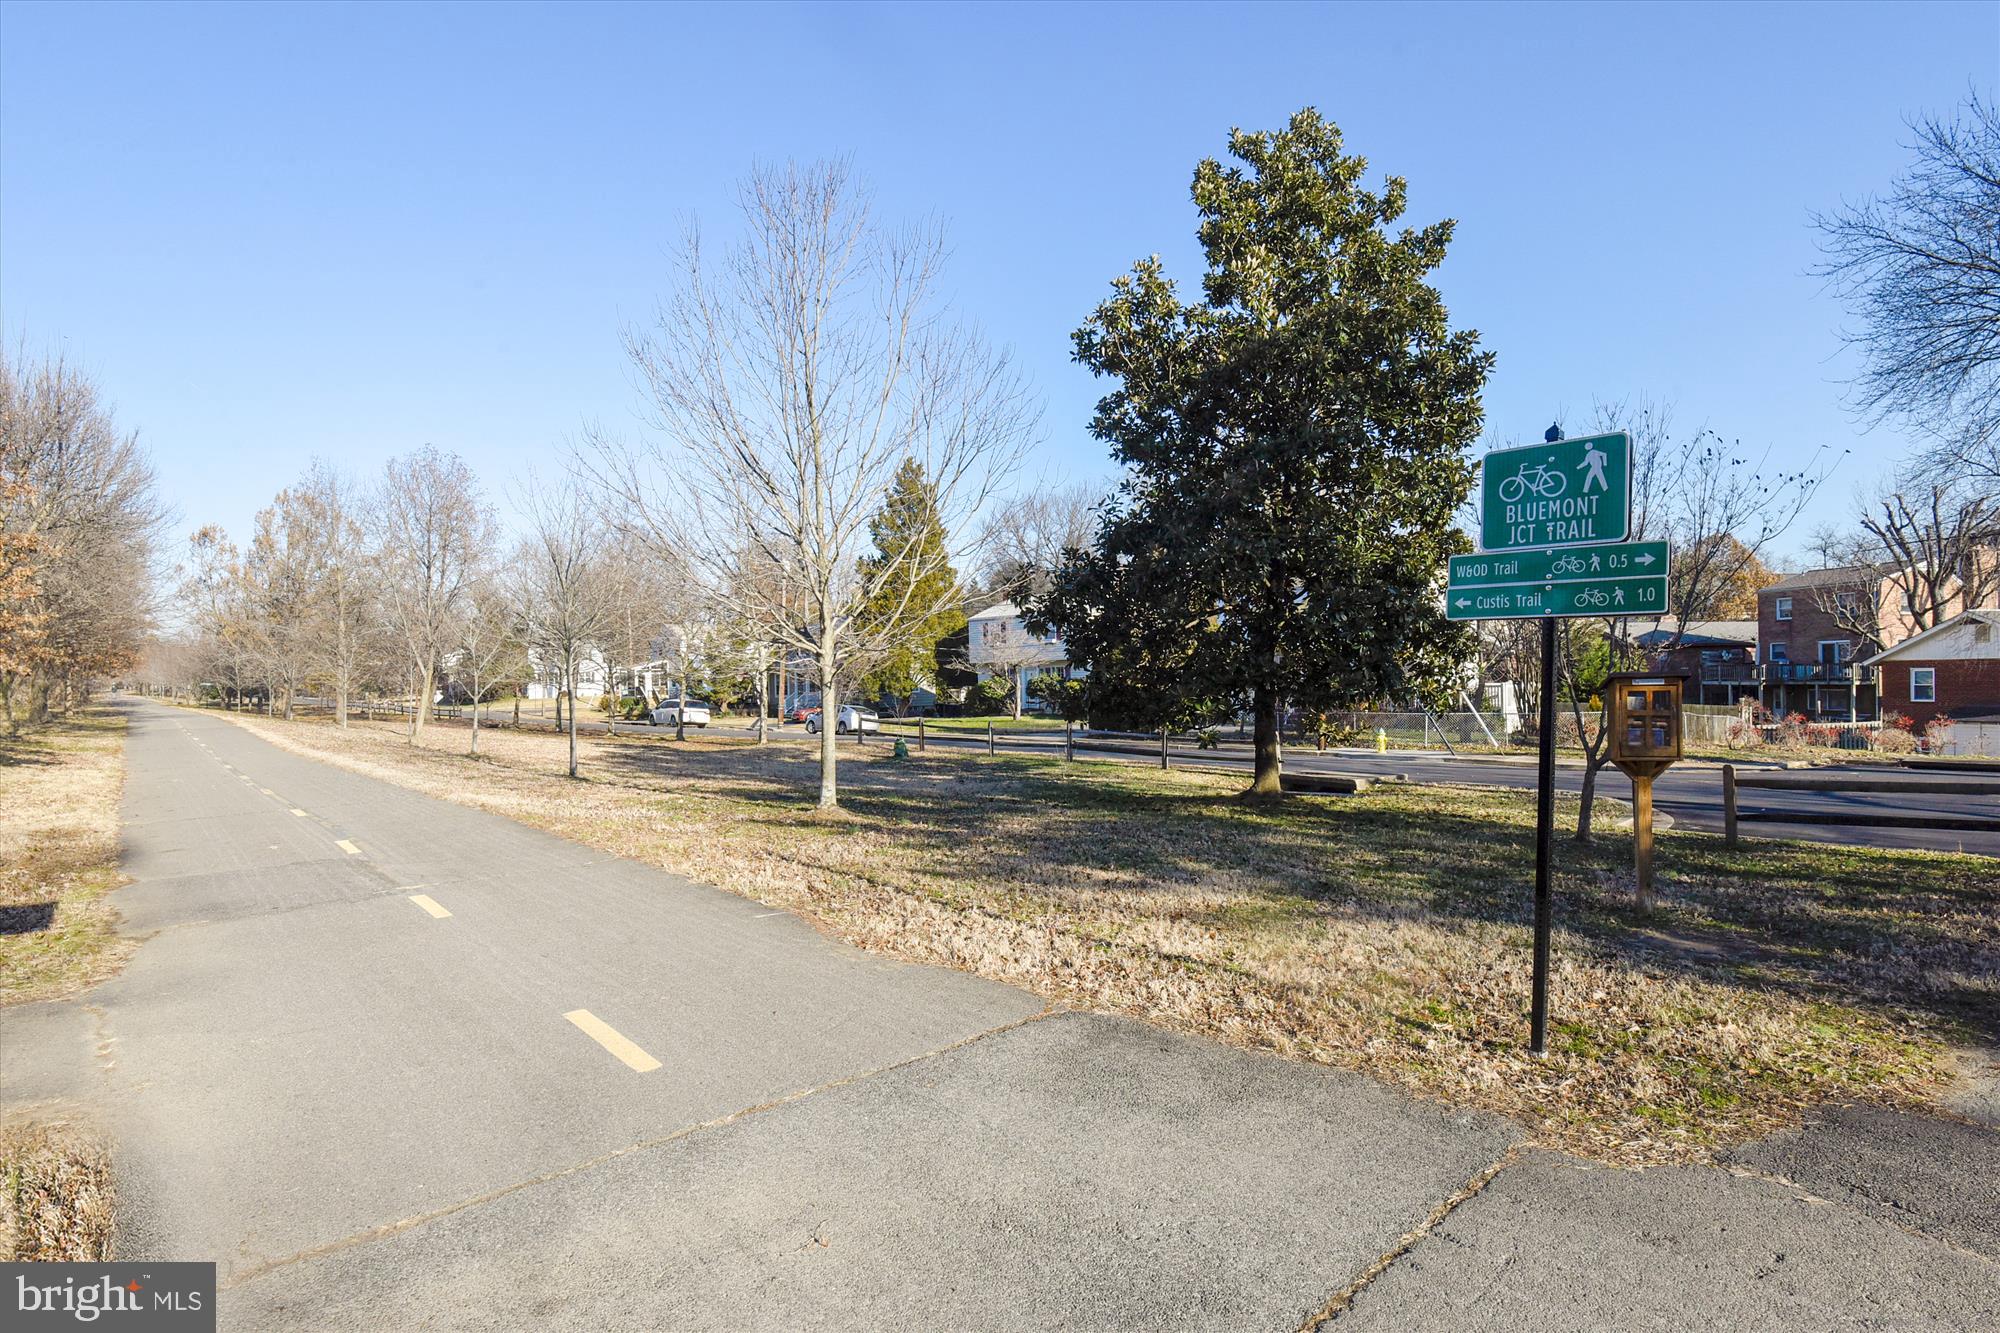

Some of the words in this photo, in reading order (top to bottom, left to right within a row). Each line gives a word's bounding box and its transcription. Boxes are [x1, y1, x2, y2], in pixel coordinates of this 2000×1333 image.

[1506, 495, 1599, 523] BLUEMONT
[1508, 523, 1536, 545] JCT
[1546, 518, 1596, 541] TRAIL
[1456, 563, 1488, 578] W&OD
[1494, 560, 1518, 576] Trail
[1609, 554, 1628, 568] 0.5
[1476, 594, 1510, 609] Custis
[1516, 592, 1542, 607] Trail
[1637, 587, 1656, 602] 1.0
